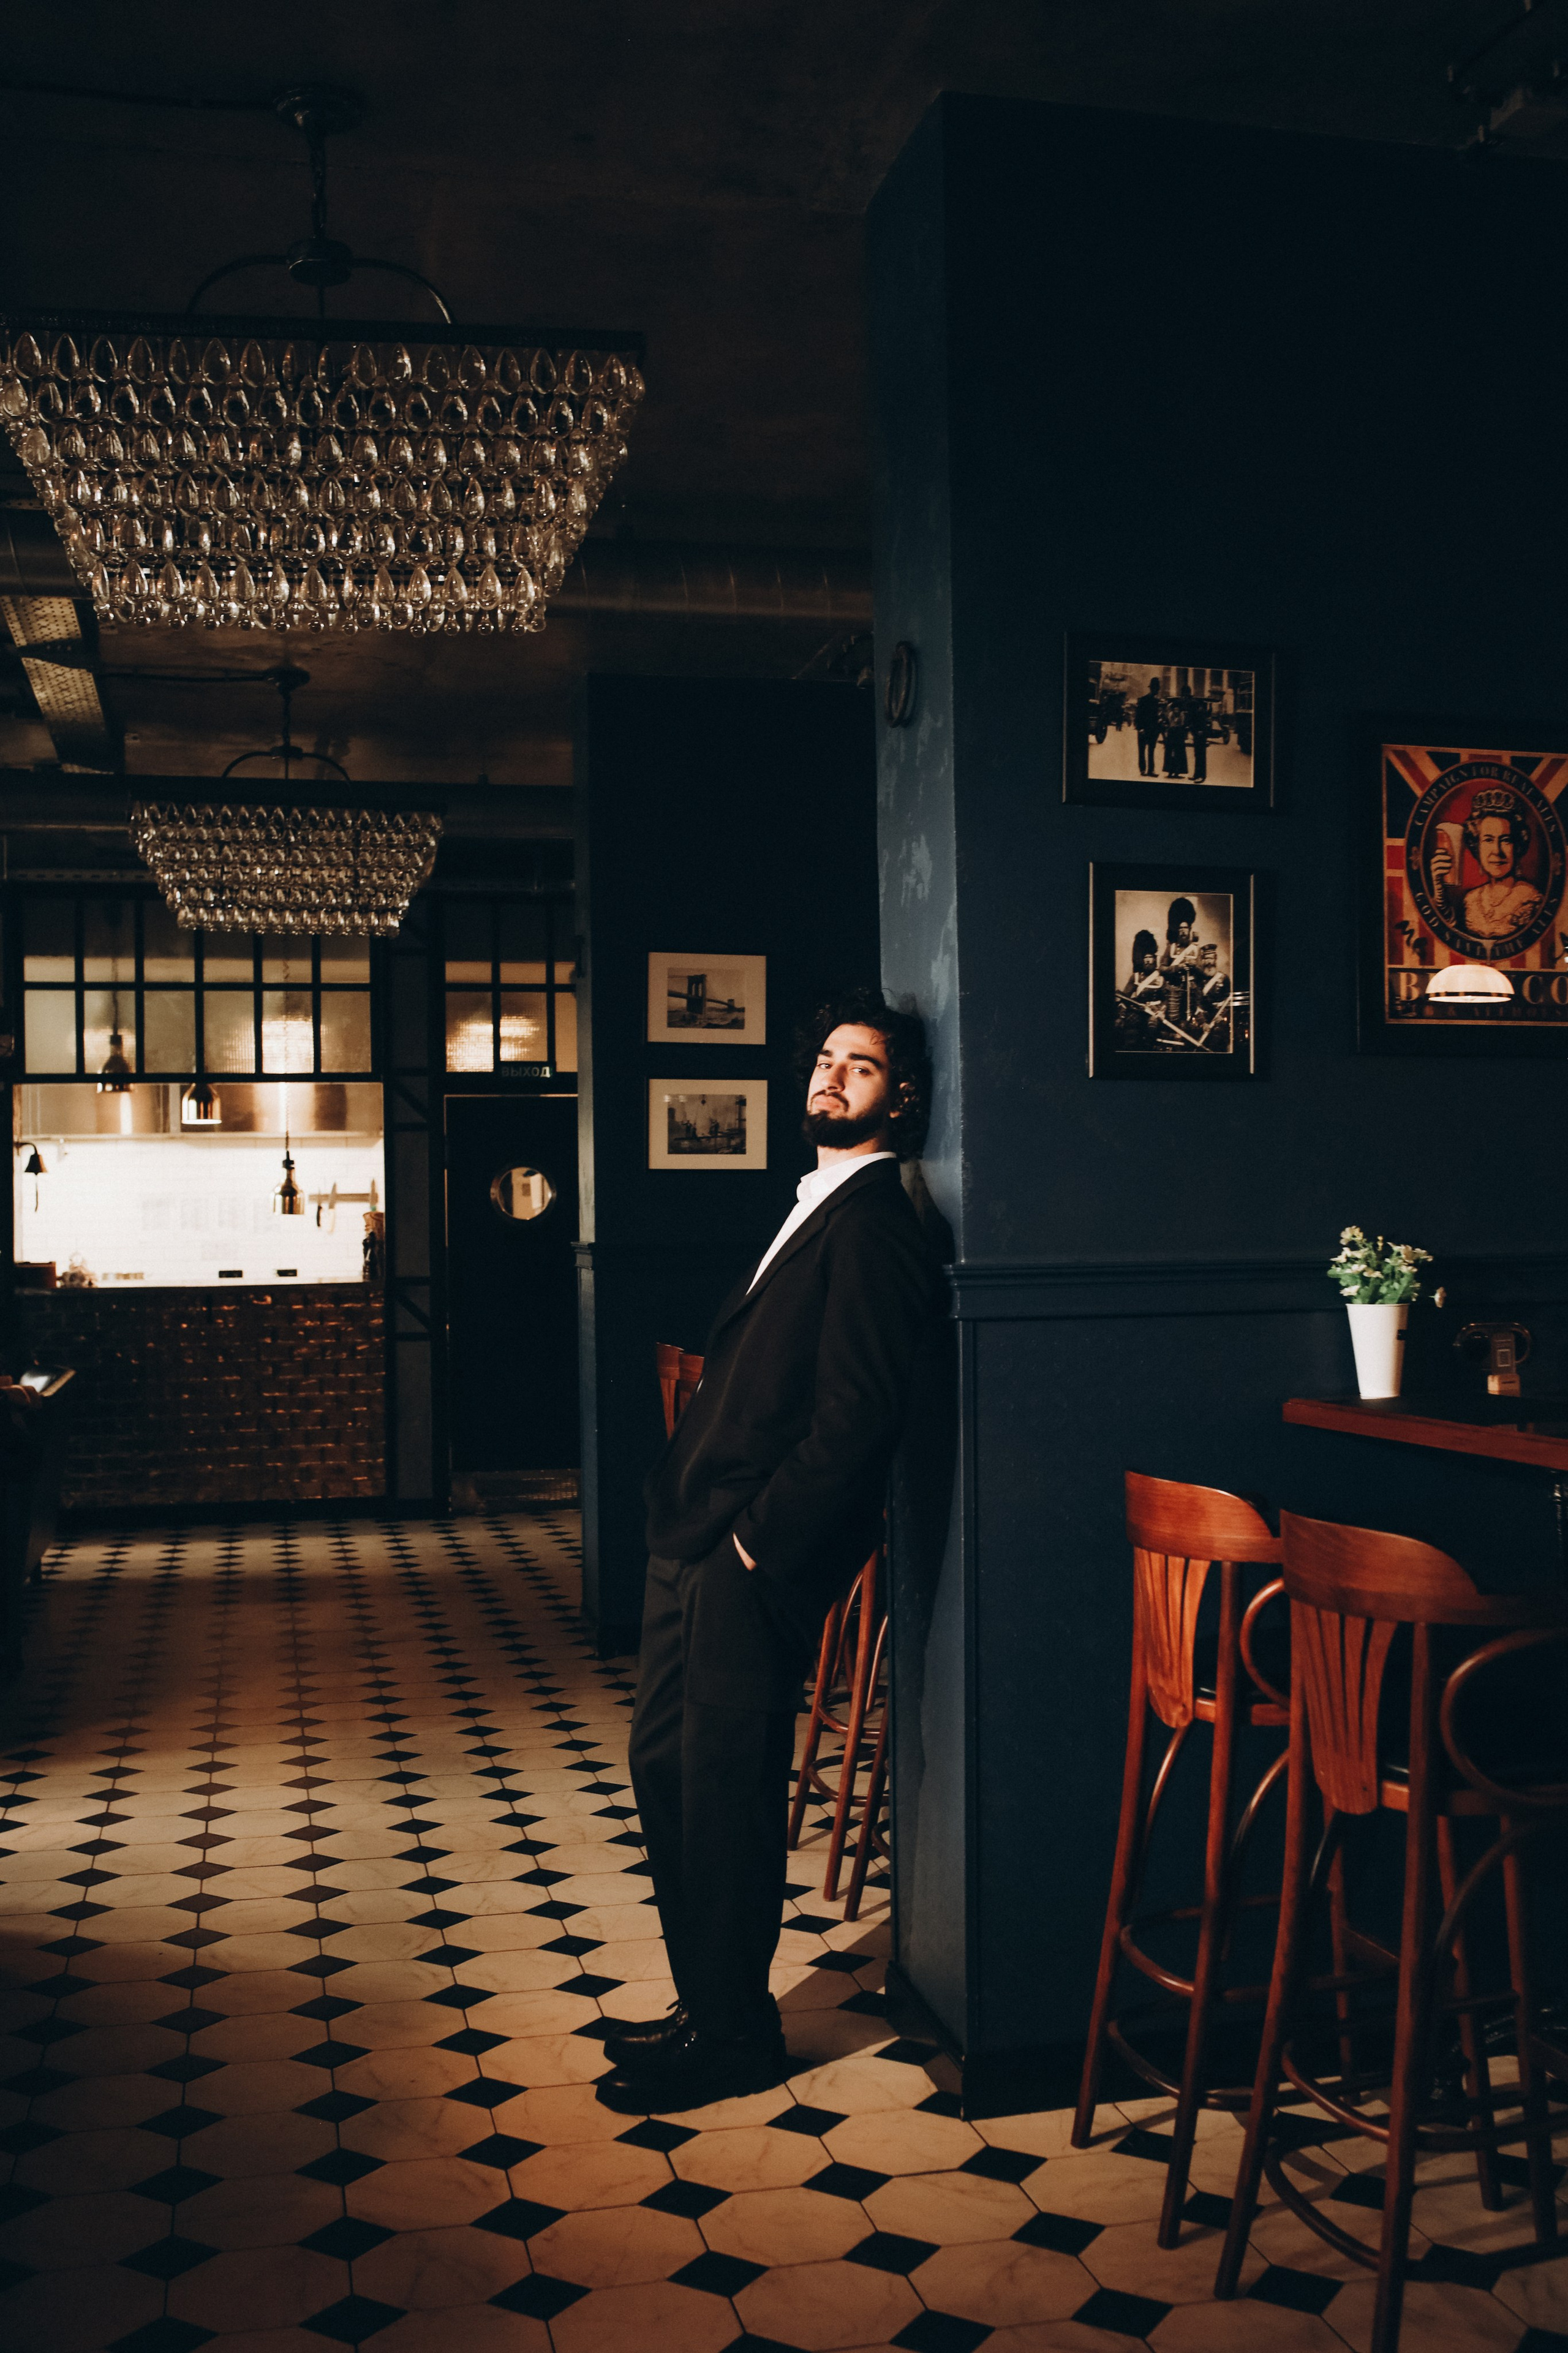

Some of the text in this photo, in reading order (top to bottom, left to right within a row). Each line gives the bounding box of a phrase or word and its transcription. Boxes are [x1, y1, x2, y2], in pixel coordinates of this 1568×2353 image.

[1414, 768, 1469, 826] CAMPAIGN
[1471, 766, 1499, 778] FOR
[1502, 770, 1534, 796] REAL
[1414, 892, 1439, 928] GOD
[502, 1066, 551, 1078] ВЫХОД
